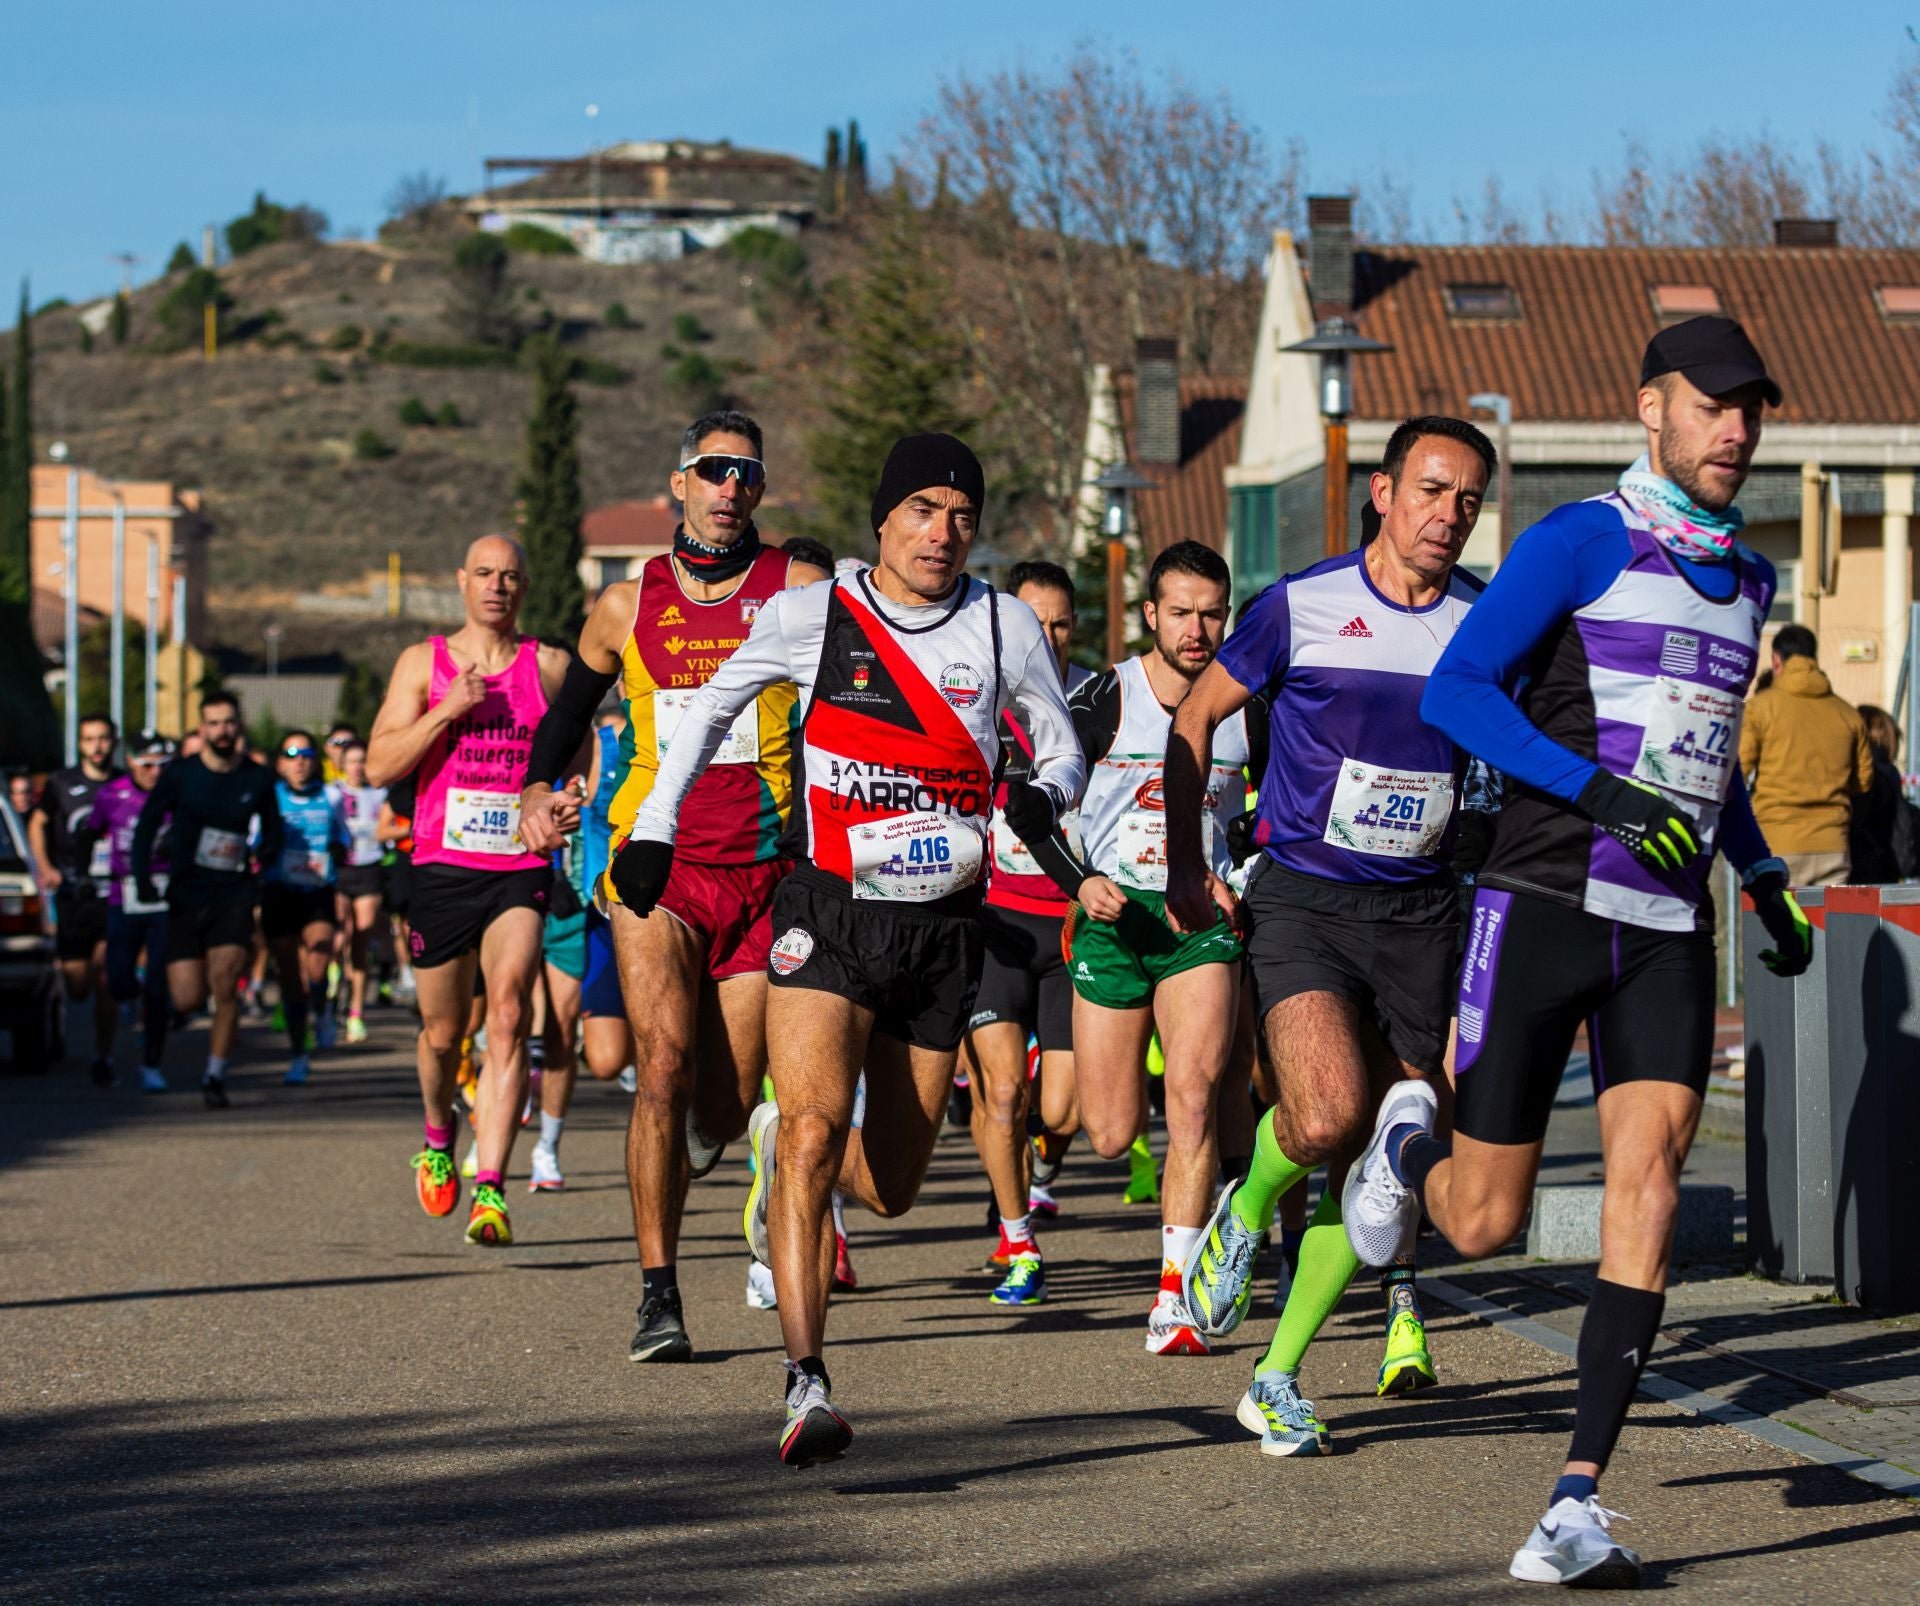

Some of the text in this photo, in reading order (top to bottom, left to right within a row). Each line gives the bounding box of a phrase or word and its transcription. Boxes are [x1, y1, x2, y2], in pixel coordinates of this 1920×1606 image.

[688, 639, 746, 650] CAJA RUR
[1338, 628, 1373, 638] adidas
[1708, 643, 1750, 669] Racing
[671, 673, 693, 686] DE
[1705, 721, 1731, 753] 72
[457, 771, 512, 784] Valladolid
[830, 760, 840, 810] CLUB
[844, 761, 980, 784] ATLETISMO
[844, 781, 980, 818] ARROYO
[1384, 794, 1426, 821] 261
[483, 811, 508, 827] 148
[908, 836, 950, 864] 416
[792, 929, 809, 938] CLUB
[1478, 909, 1502, 971] Racing
[1463, 906, 1486, 993] Valladolid
